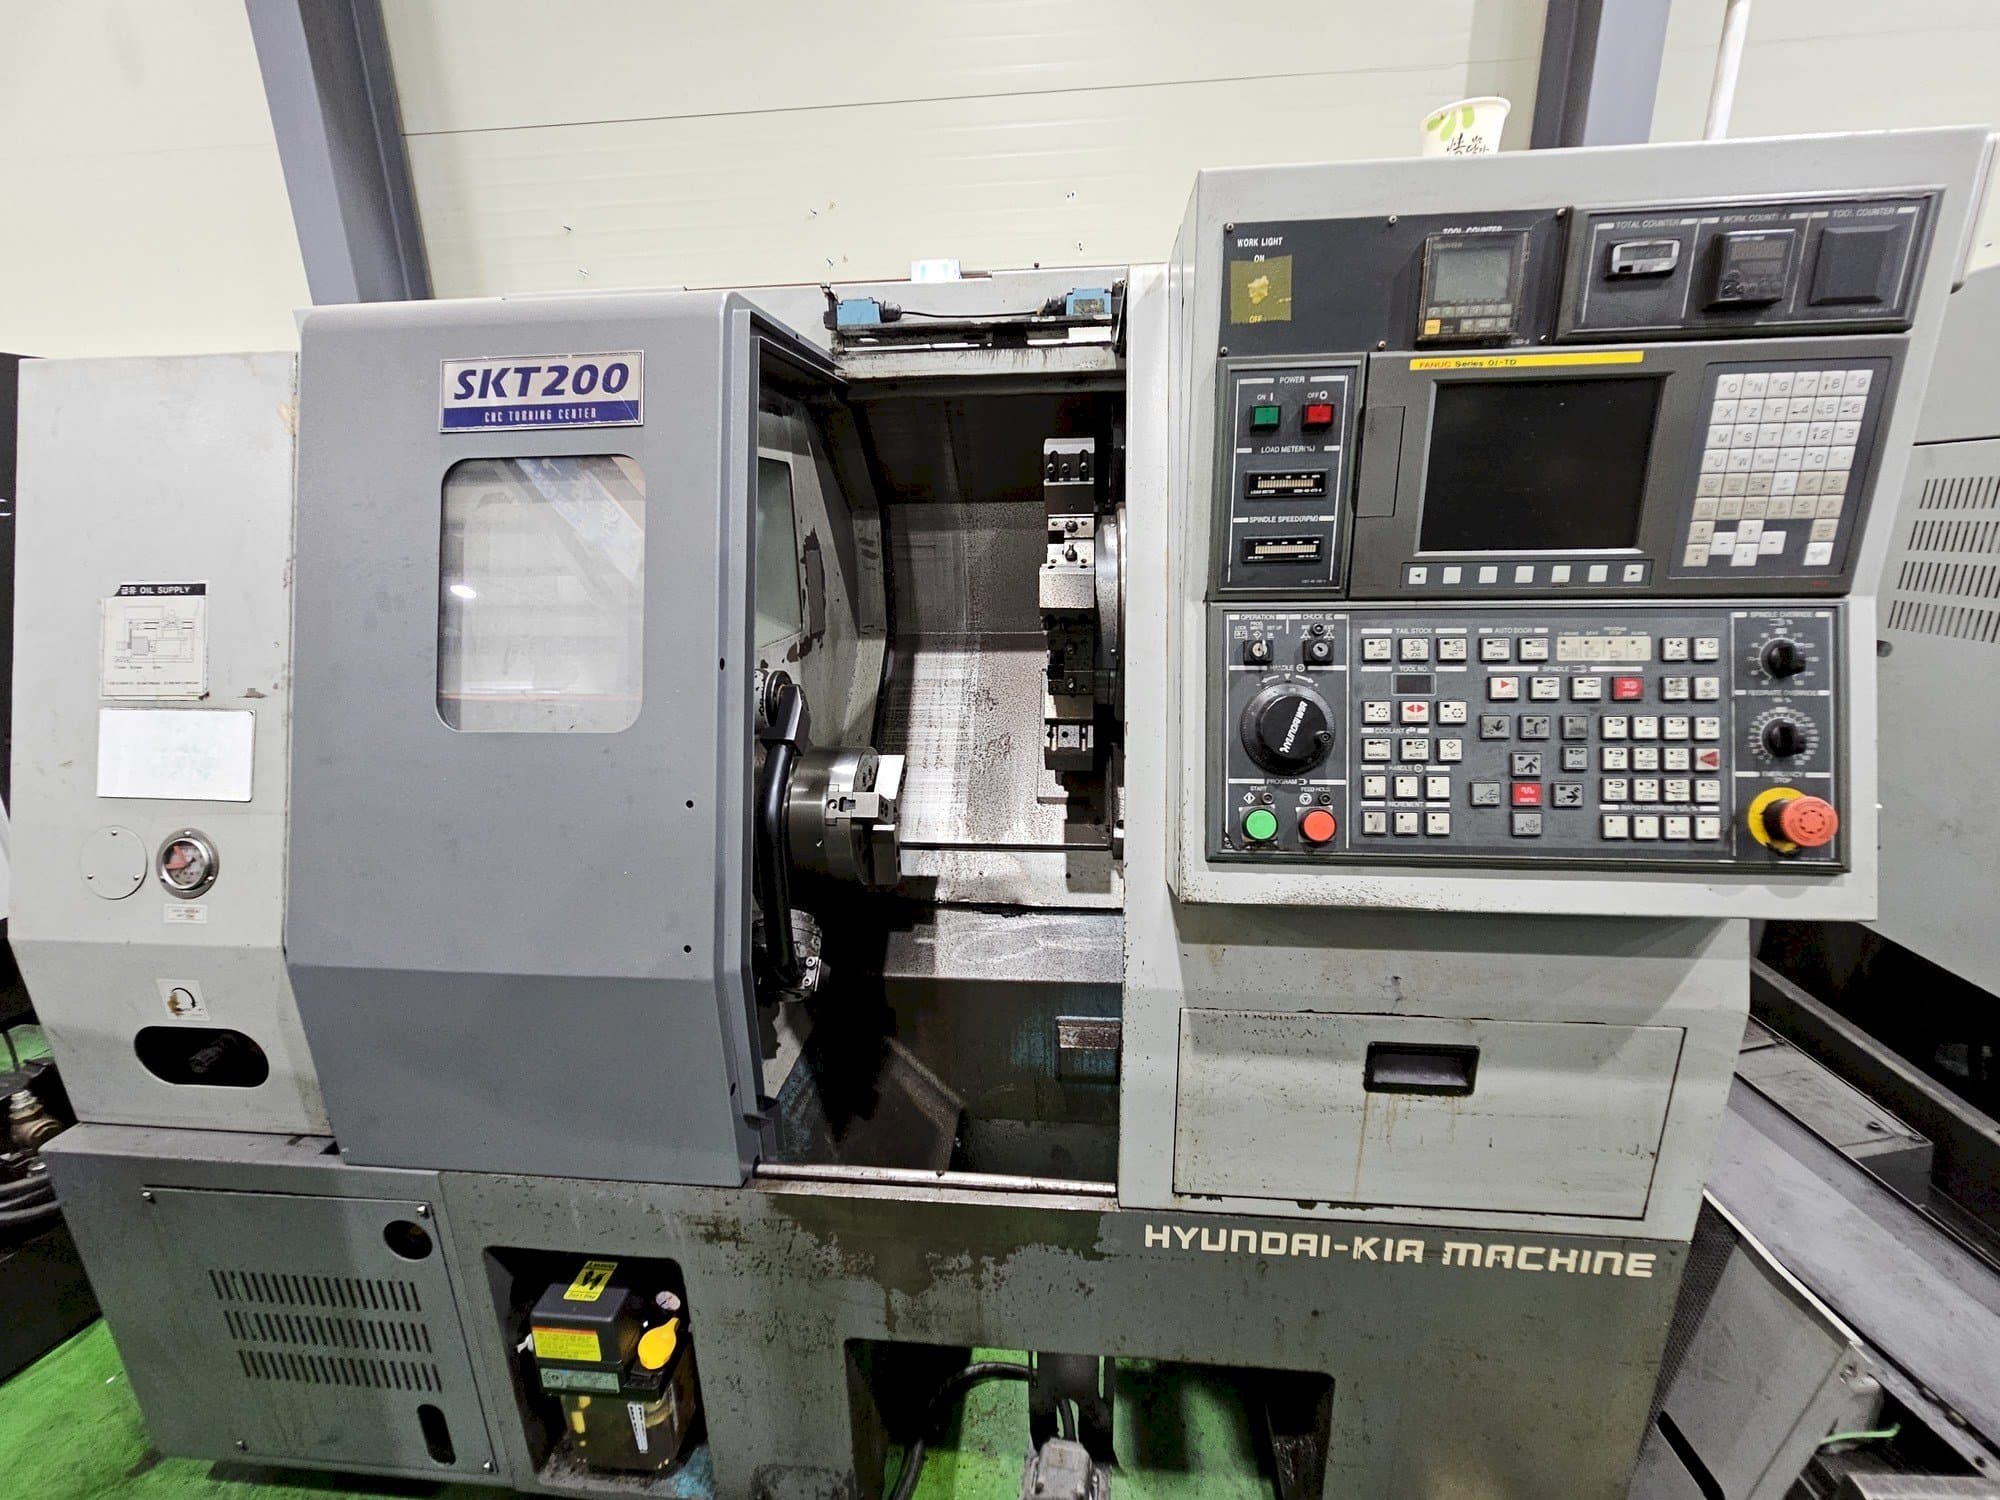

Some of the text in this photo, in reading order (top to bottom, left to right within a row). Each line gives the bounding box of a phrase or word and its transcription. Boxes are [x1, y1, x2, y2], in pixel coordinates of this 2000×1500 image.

[1237, 236, 1283, 247] WORK LIGHT
[1254, 254, 1265, 263] ON
[1418, 360, 1451, 369] FANUC
[1454, 358, 1485, 368] Series
[453, 362, 630, 400] SKT200
[1279, 375, 1305, 384] POWER
[484, 407, 597, 423] CNC TURNING CENTER
[1261, 446, 1281, 454] LOAD
[1249, 515, 1276, 524] SPINDLE
[139, 585, 191, 595] OIL SUPPLY
[1144, 1224, 1657, 1279] HYUNDAI-KIA MACHINE
